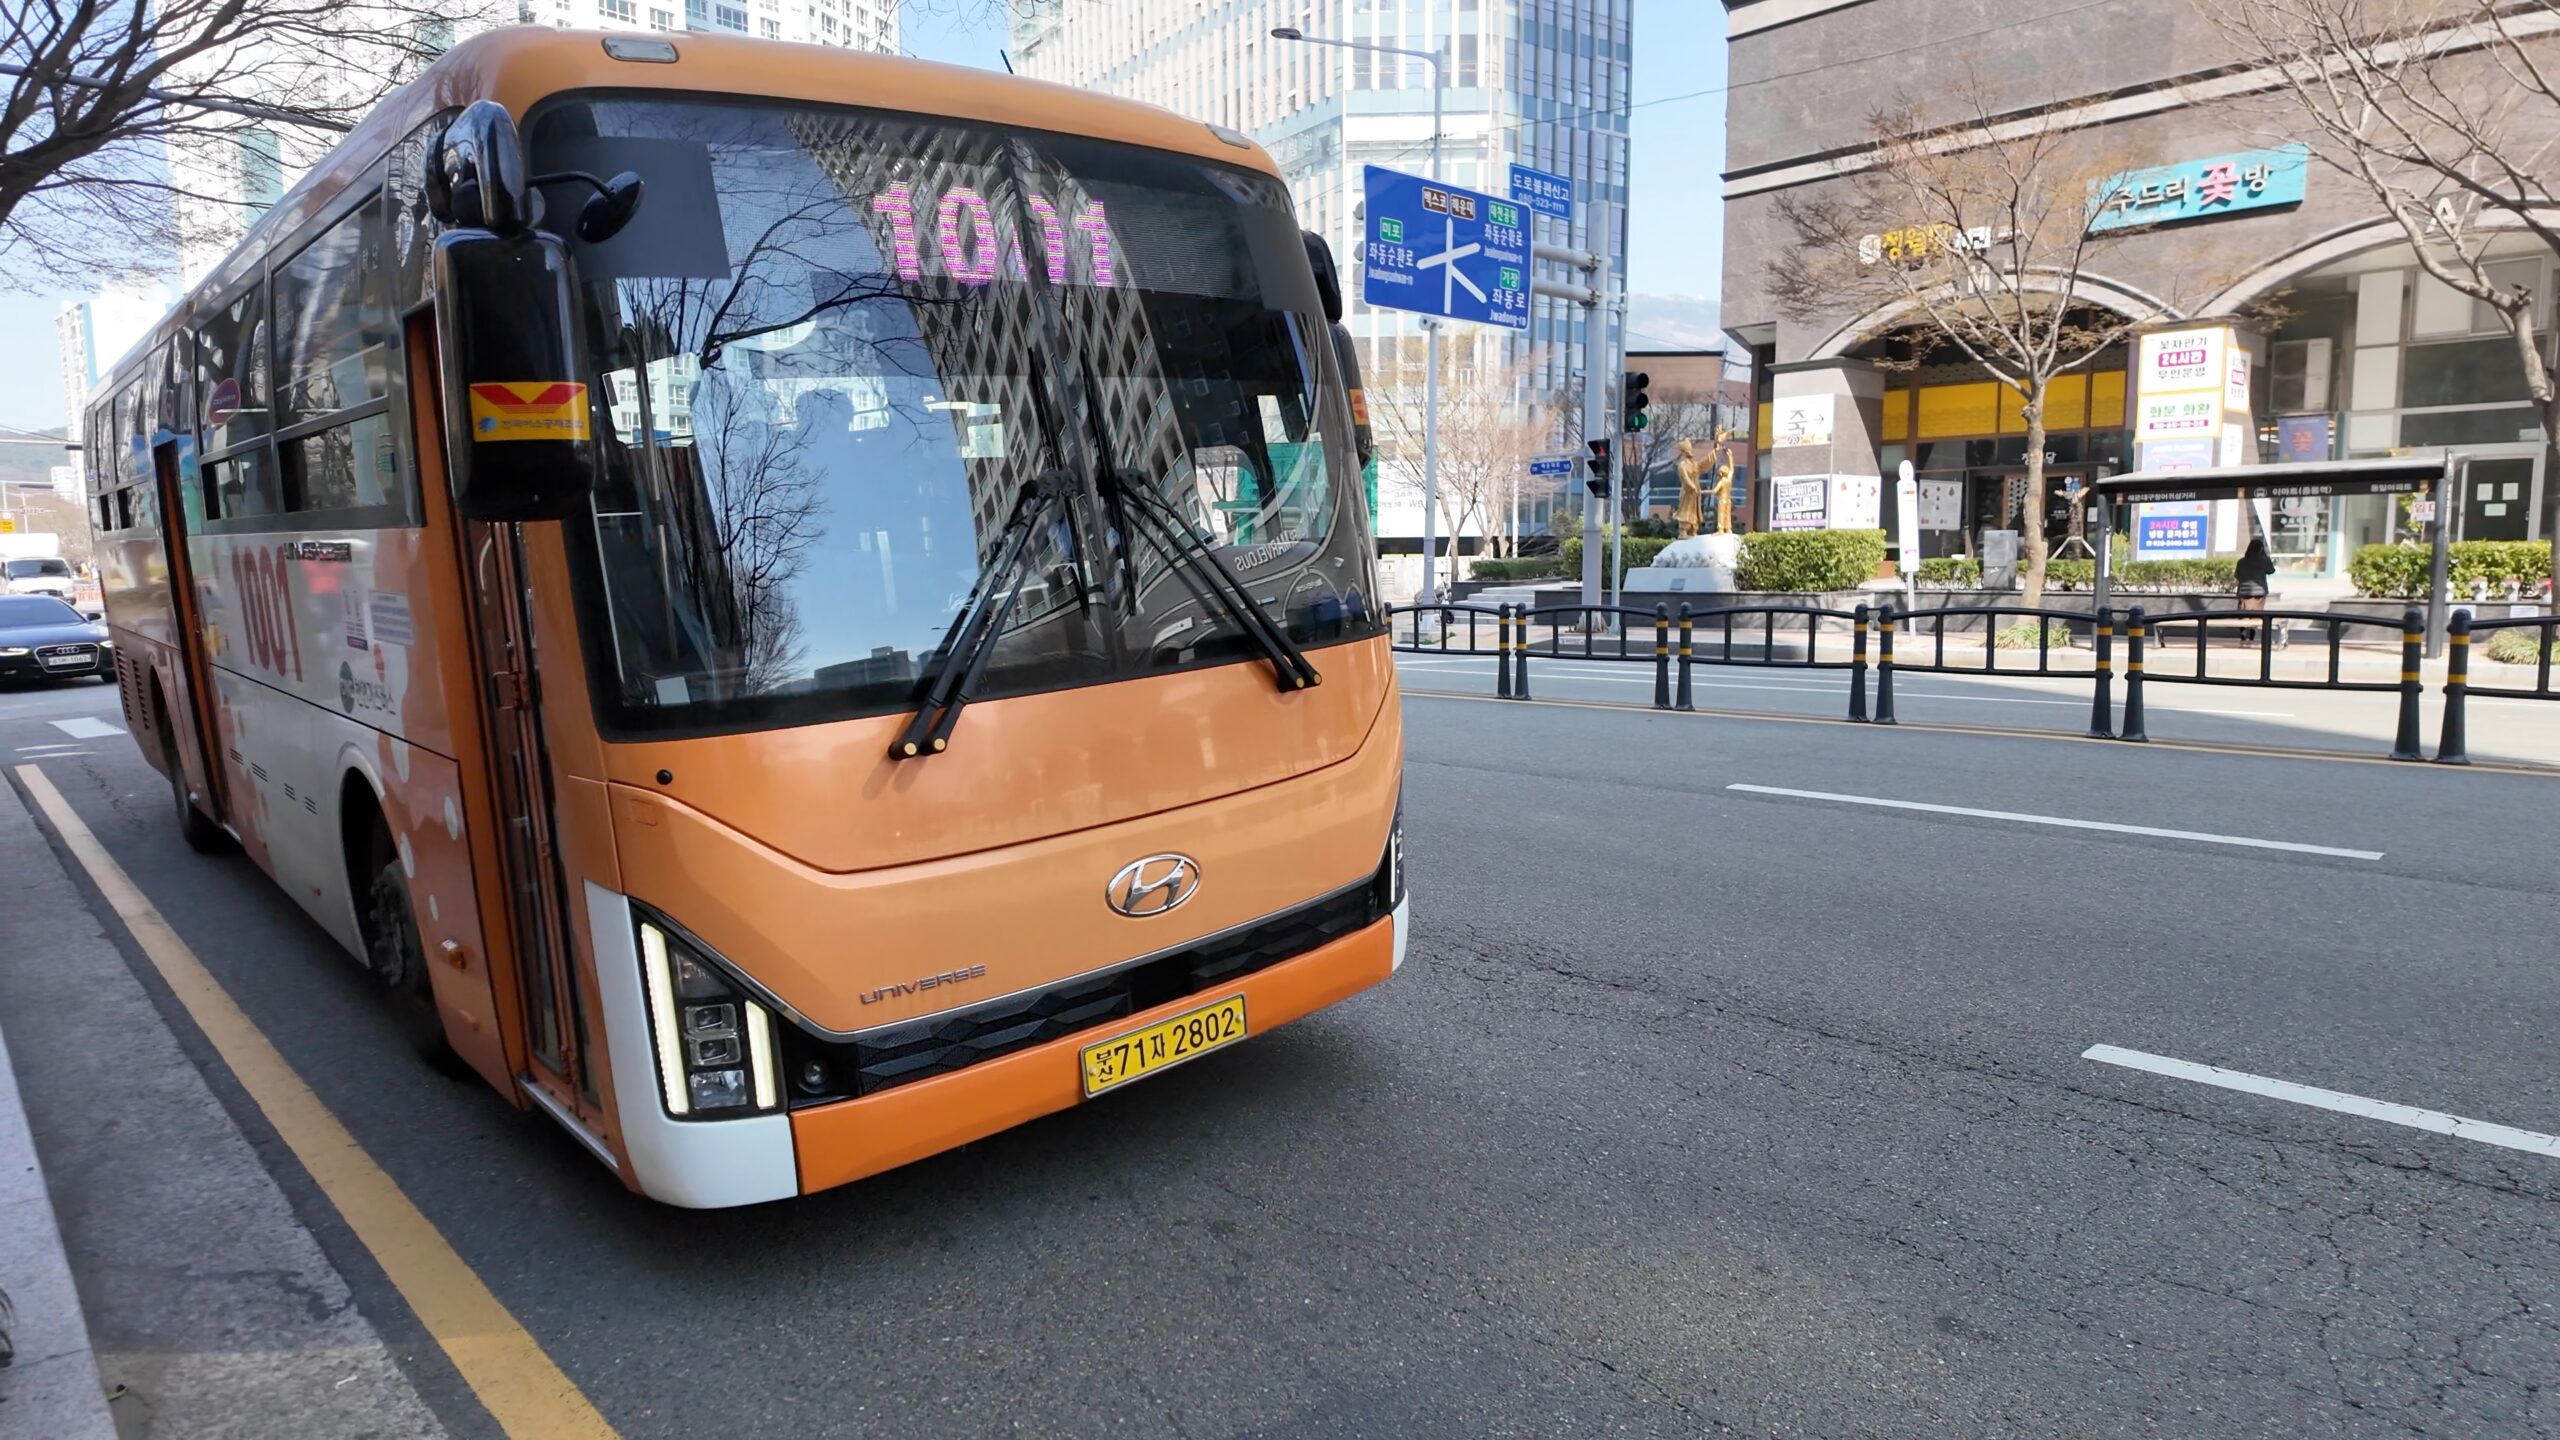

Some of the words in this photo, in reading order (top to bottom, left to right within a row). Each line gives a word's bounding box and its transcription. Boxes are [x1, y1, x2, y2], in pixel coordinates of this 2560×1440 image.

[1513, 174, 1569, 200] 도로불편신고
[1424, 191, 1447, 207] 벡스코
[1453, 197, 1474, 215] 해운대
[1490, 204, 1516, 224] 대천공원
[1382, 222, 1401, 238] 미포
[1484, 224, 1523, 248] 좌동순환로
[1369, 243, 1414, 268] 좌동순환로
[1502, 271, 1518, 288] 기장
[1492, 288, 1525, 309] 좌동로
[1489, 309, 1527, 326] Jwadong-ro
[2161, 350, 2203, 366] 24시간
[1787, 409, 1808, 435] 죽
[860, 963, 986, 1005] UNIVERSE
[1172, 1007, 1236, 1056] 2802
